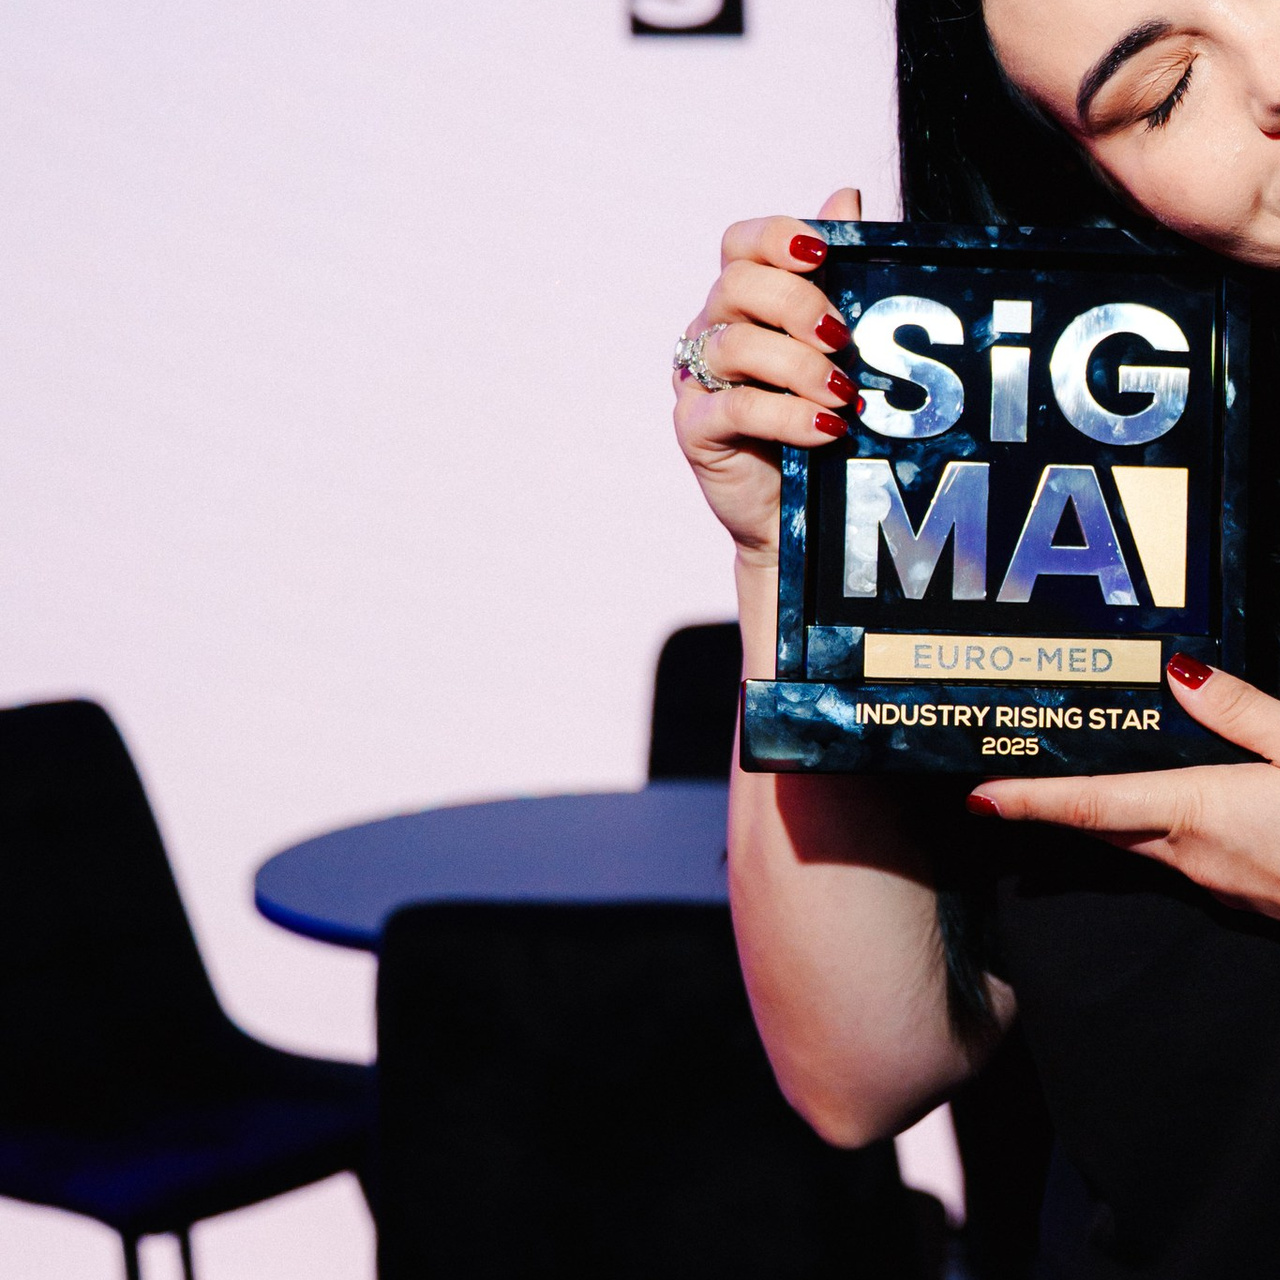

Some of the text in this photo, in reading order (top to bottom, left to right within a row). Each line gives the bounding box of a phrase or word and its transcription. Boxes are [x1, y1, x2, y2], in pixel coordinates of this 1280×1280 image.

[853, 295, 1191, 446] SiG
[843, 458, 1140, 606] MA
[913, 644, 1114, 673] EURO-MED
[856, 703, 1161, 731] INDUSTRY RISING STAR
[981, 737, 1039, 755] 2025
